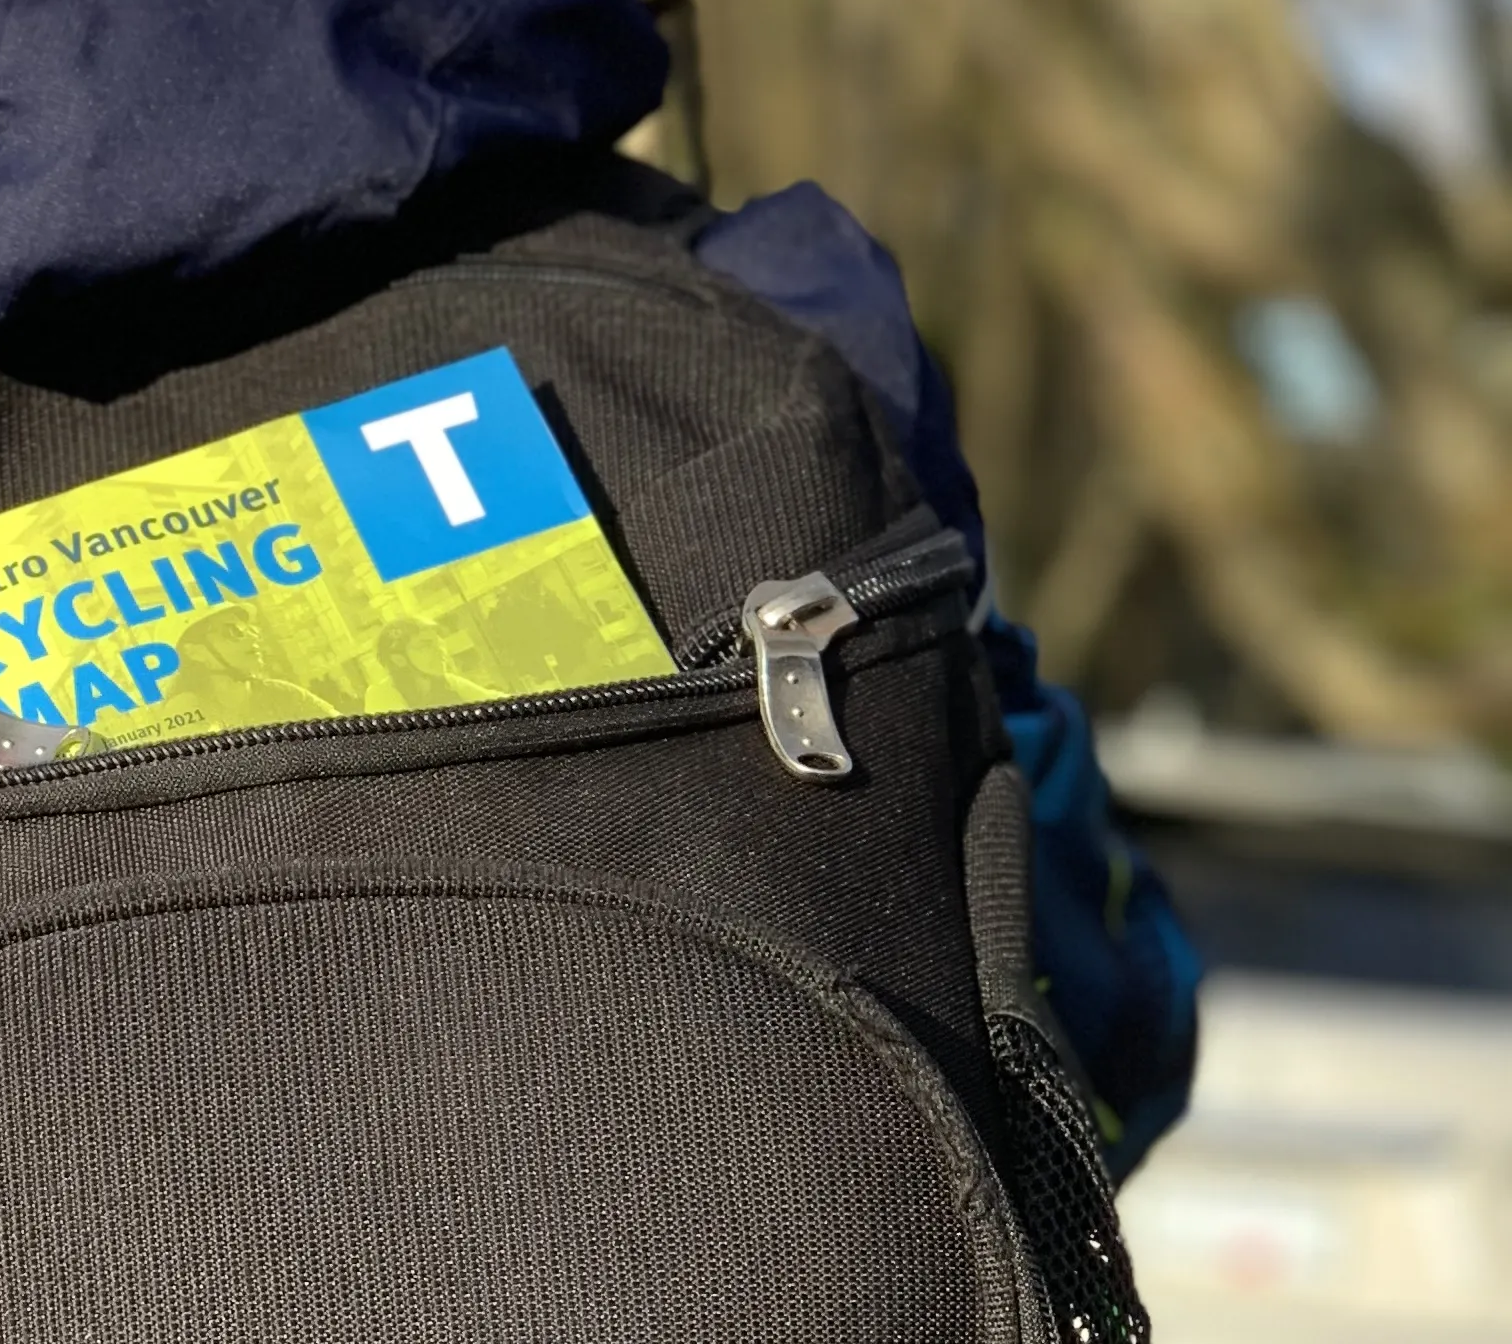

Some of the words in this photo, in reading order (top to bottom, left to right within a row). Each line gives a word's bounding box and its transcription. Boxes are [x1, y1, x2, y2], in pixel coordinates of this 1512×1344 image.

[361, 392, 485, 526] T
[51, 479, 281, 564] Vancouver
[163, 708, 206, 731] 2021
